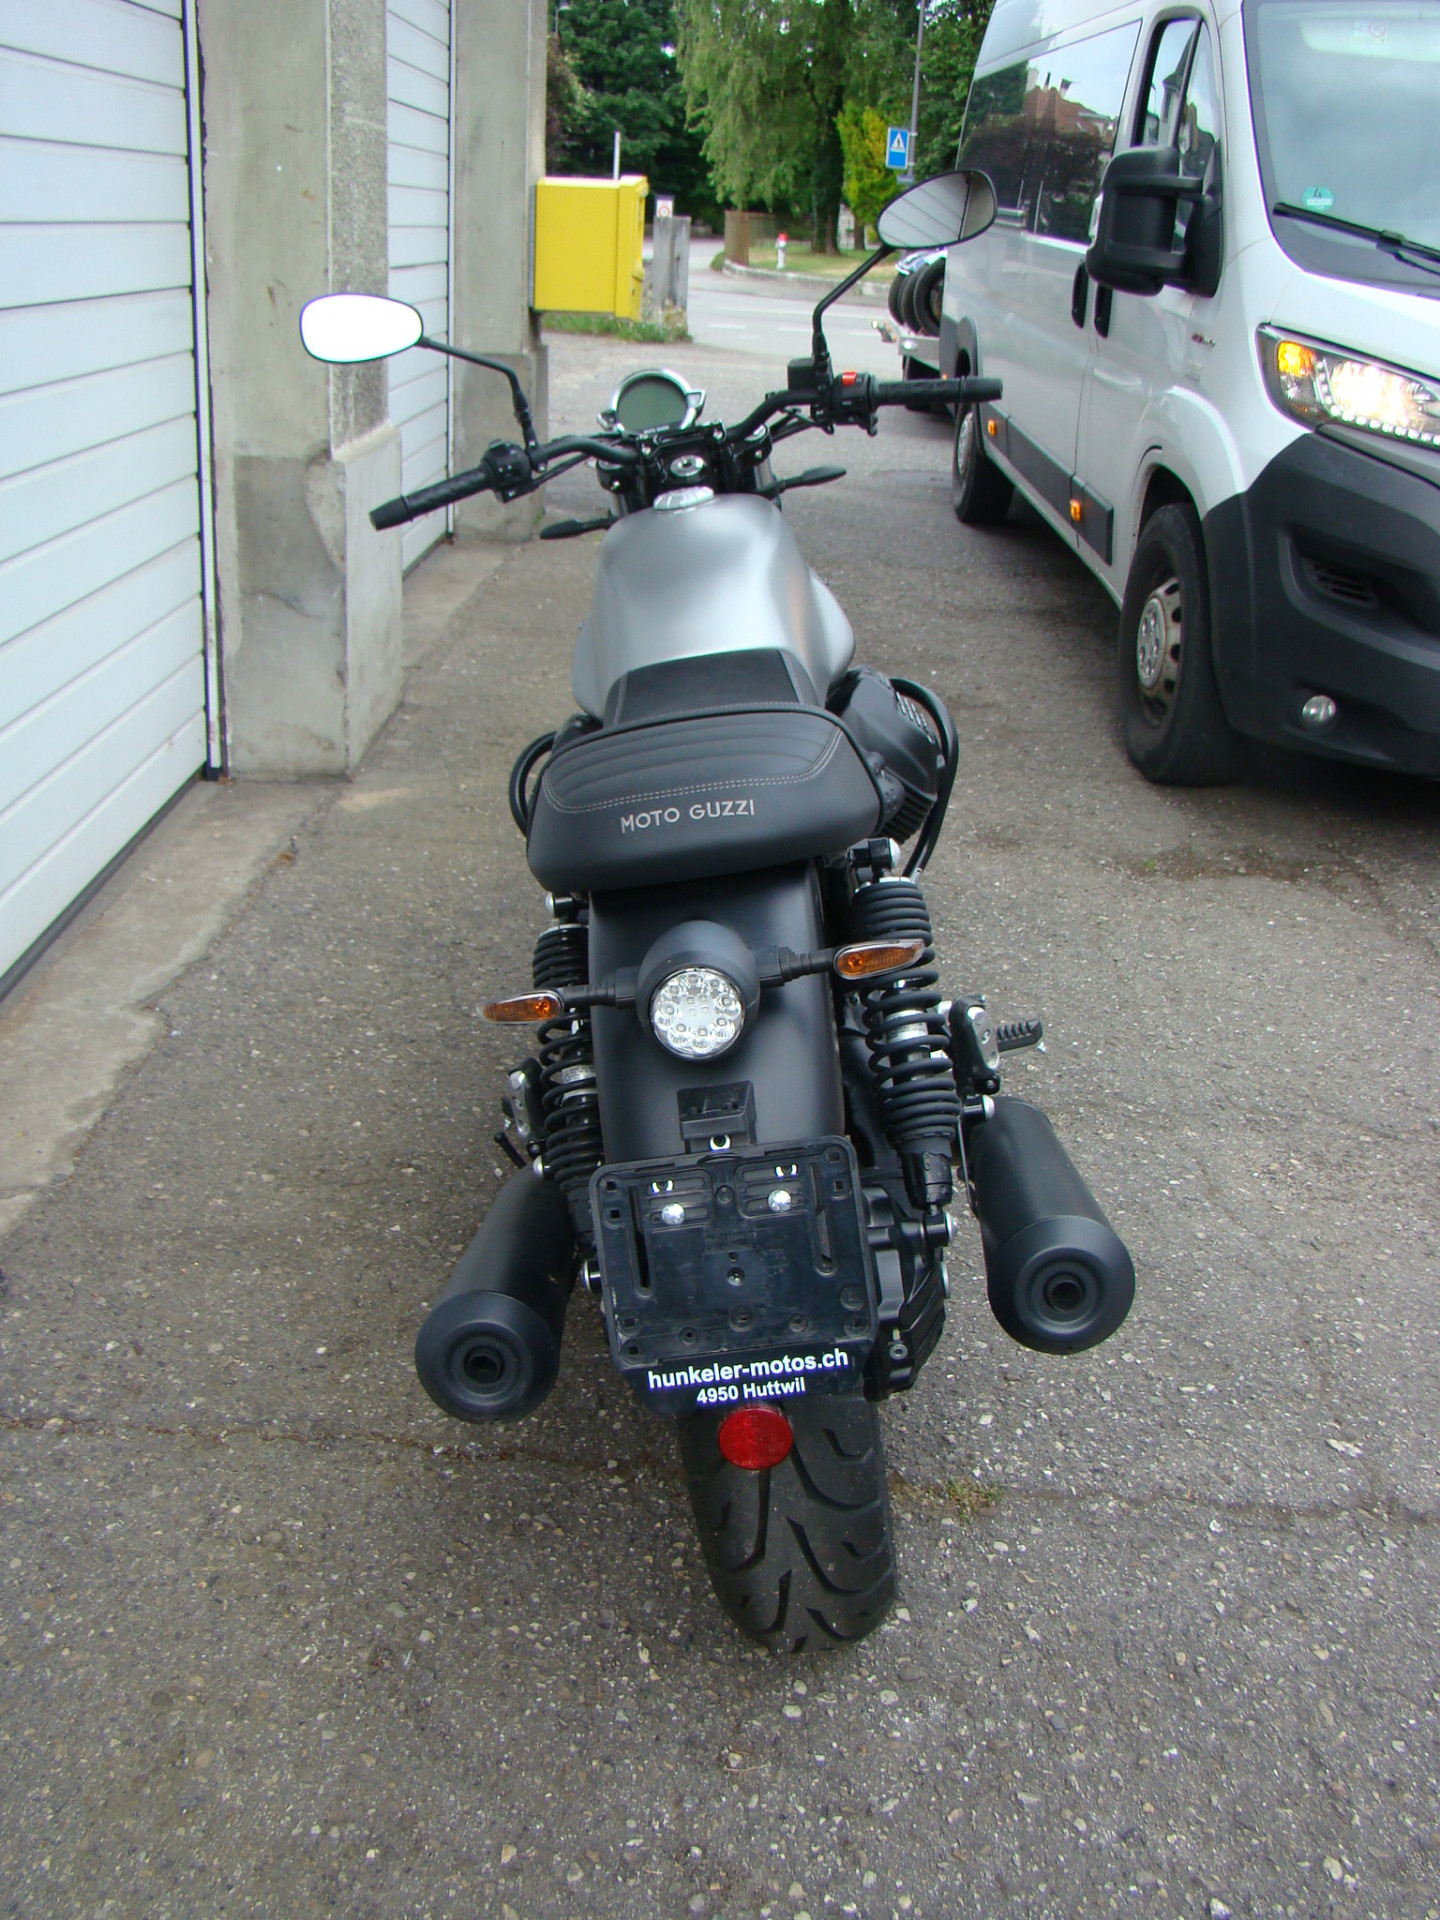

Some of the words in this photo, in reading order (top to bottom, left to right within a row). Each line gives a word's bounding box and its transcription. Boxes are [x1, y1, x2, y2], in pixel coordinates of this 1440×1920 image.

[620, 807, 681, 834] MOTO
[689, 799, 755, 820] GUZZI
[647, 1348, 849, 1389] hunkeler-motos.ch
[696, 1385, 739, 1404] 4950
[743, 1377, 806, 1399] Huttwil
